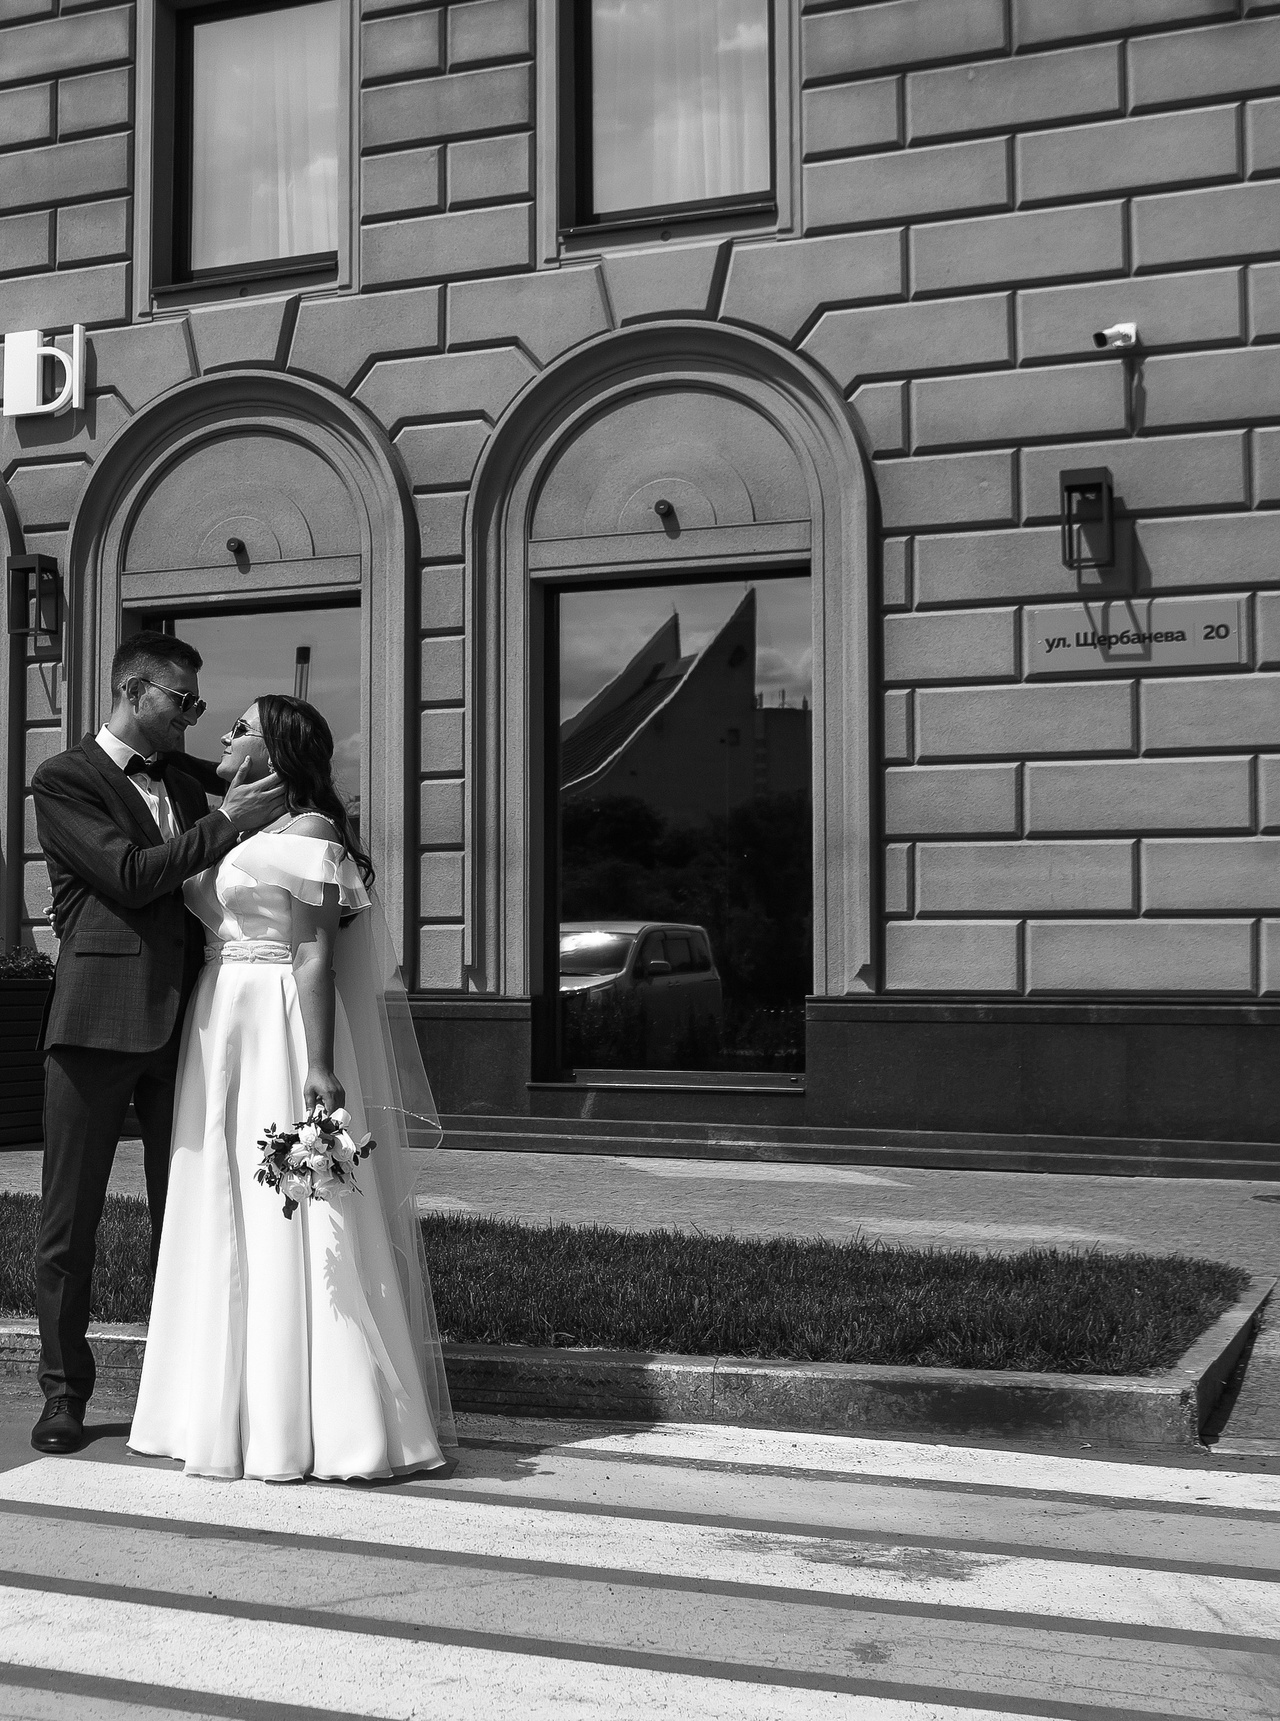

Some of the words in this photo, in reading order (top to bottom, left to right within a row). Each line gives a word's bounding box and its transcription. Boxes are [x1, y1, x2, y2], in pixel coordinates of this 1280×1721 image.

[1044, 636, 1072, 654] ул.
[1074, 629, 1188, 650] Щербанева
[1202, 623, 1231, 641] 20
